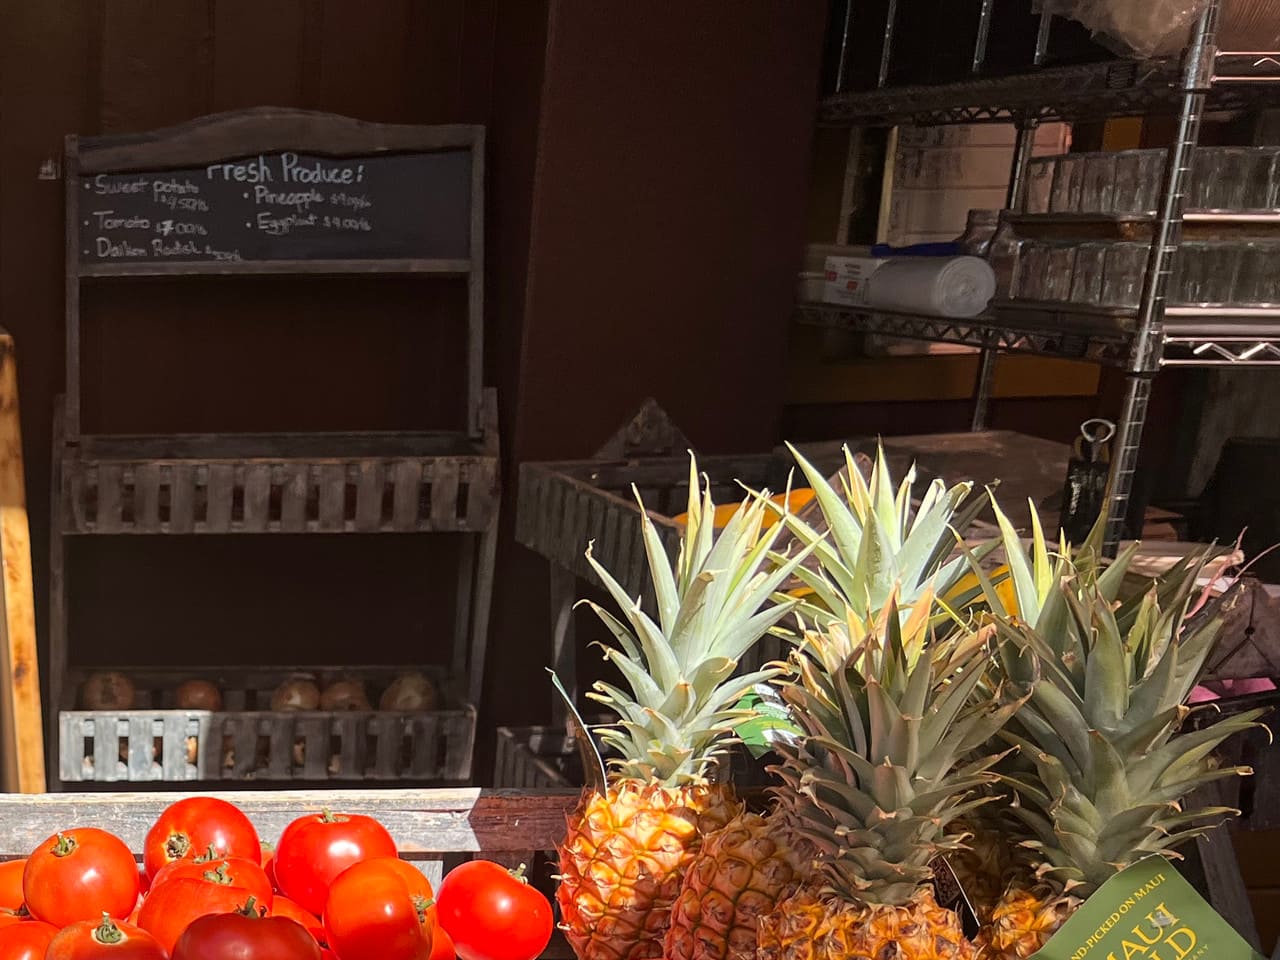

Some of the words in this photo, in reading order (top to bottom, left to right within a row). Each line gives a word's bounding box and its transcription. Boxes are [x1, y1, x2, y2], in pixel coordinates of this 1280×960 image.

[95, 174, 149, 195] Sweet
[254, 185, 325, 213] Pineapple
[92, 210, 151, 230] Tomato
[257, 212, 318, 236] Eggplant
[1118, 897, 1137, 915] ON
[1134, 873, 1167, 902] MAUI
